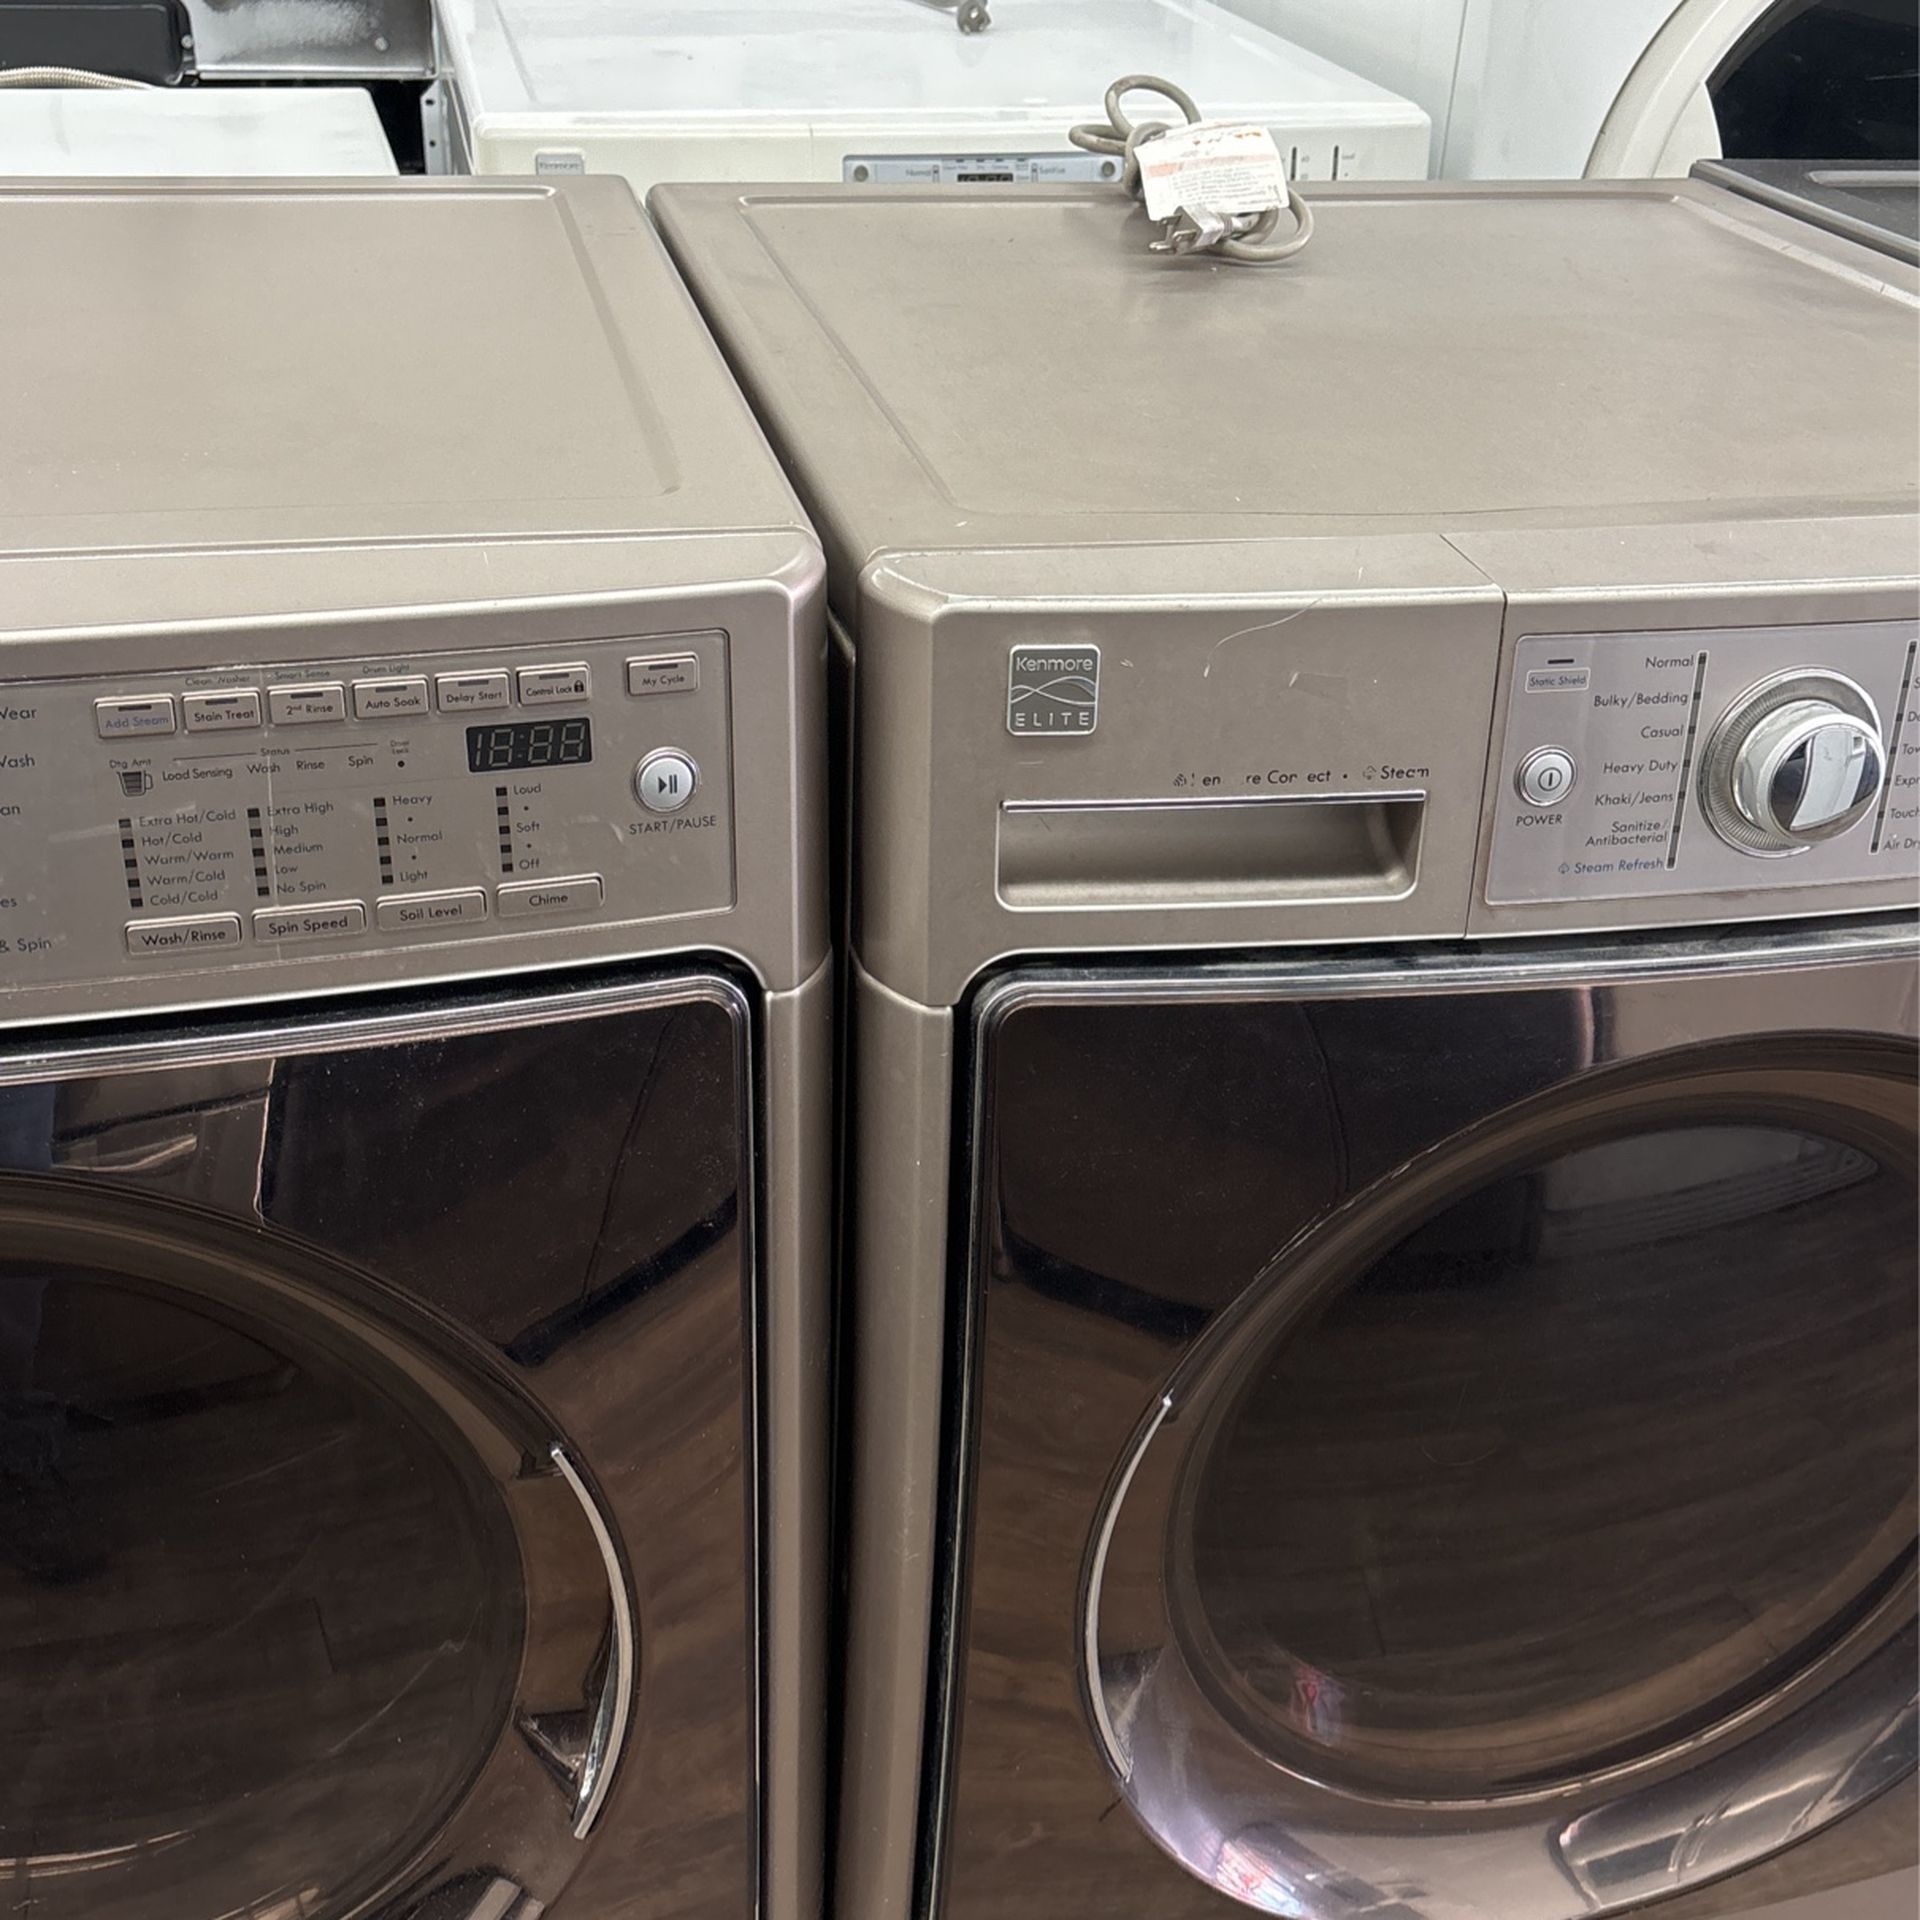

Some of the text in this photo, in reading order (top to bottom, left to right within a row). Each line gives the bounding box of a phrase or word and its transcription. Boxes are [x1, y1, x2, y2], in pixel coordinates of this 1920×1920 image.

[1015, 655, 1094, 673] Kenmore
[1645, 654, 1695, 669] Normal
[641, 673, 685, 687] My Cycle
[1528, 673, 1586, 687] Static Shield
[445, 690, 503, 704] Delay Start
[525, 684, 573, 697] Control Lock
[365, 696, 422, 710] Auto Soak
[1593, 690, 1689, 708] Bulky/Bedding
[193, 708, 255, 723] Stain Treat
[305, 702, 334, 714] Rinse
[105, 715, 170, 729] Add Steam
[1014, 711, 1090, 728] ELITE
[1640, 724, 1684, 739] Casual
[260, 746, 290, 756] Status
[296, 758, 326, 771] Rinse
[348, 754, 374, 767] Spin
[1603, 759, 1679, 776] Heavy Duty
[162, 766, 233, 781] Load Sensing
[247, 762, 281, 775] Wash
[513, 783, 542, 795] Loud
[391, 793, 433, 808] Heavy
[1594, 790, 1674, 807] Khaki/Jeans
[267, 801, 335, 817] Extra High
[138, 809, 237, 827] Extra Hot/Cold
[628, 815, 717, 836] START/PAUSE
[1515, 813, 1563, 827] POWER
[269, 824, 300, 838] High
[516, 821, 540, 833] Soft
[141, 832, 203, 848] Hot/Cold
[396, 831, 443, 844] Normal
[1585, 831, 1668, 848] Antibacterial
[1882, 837, 1901, 851] Air
[273, 842, 324, 855] Medium
[144, 849, 235, 865] Warm/Warm
[518, 858, 541, 870] Off
[274, 864, 298, 876] Low
[1573, 857, 1664, 875] Steam Refresh
[146, 870, 226, 886] Warm/Cold
[399, 870, 429, 884] Light
[276, 881, 327, 895] No Spin
[149, 890, 219, 906] Cold/Cold
[528, 892, 569, 907] Chime
[399, 904, 463, 922] Soil Level
[268, 916, 348, 936] Spin Speed
[141, 928, 227, 947] Wash/Rinse
[17, 938, 52, 953] Spin
